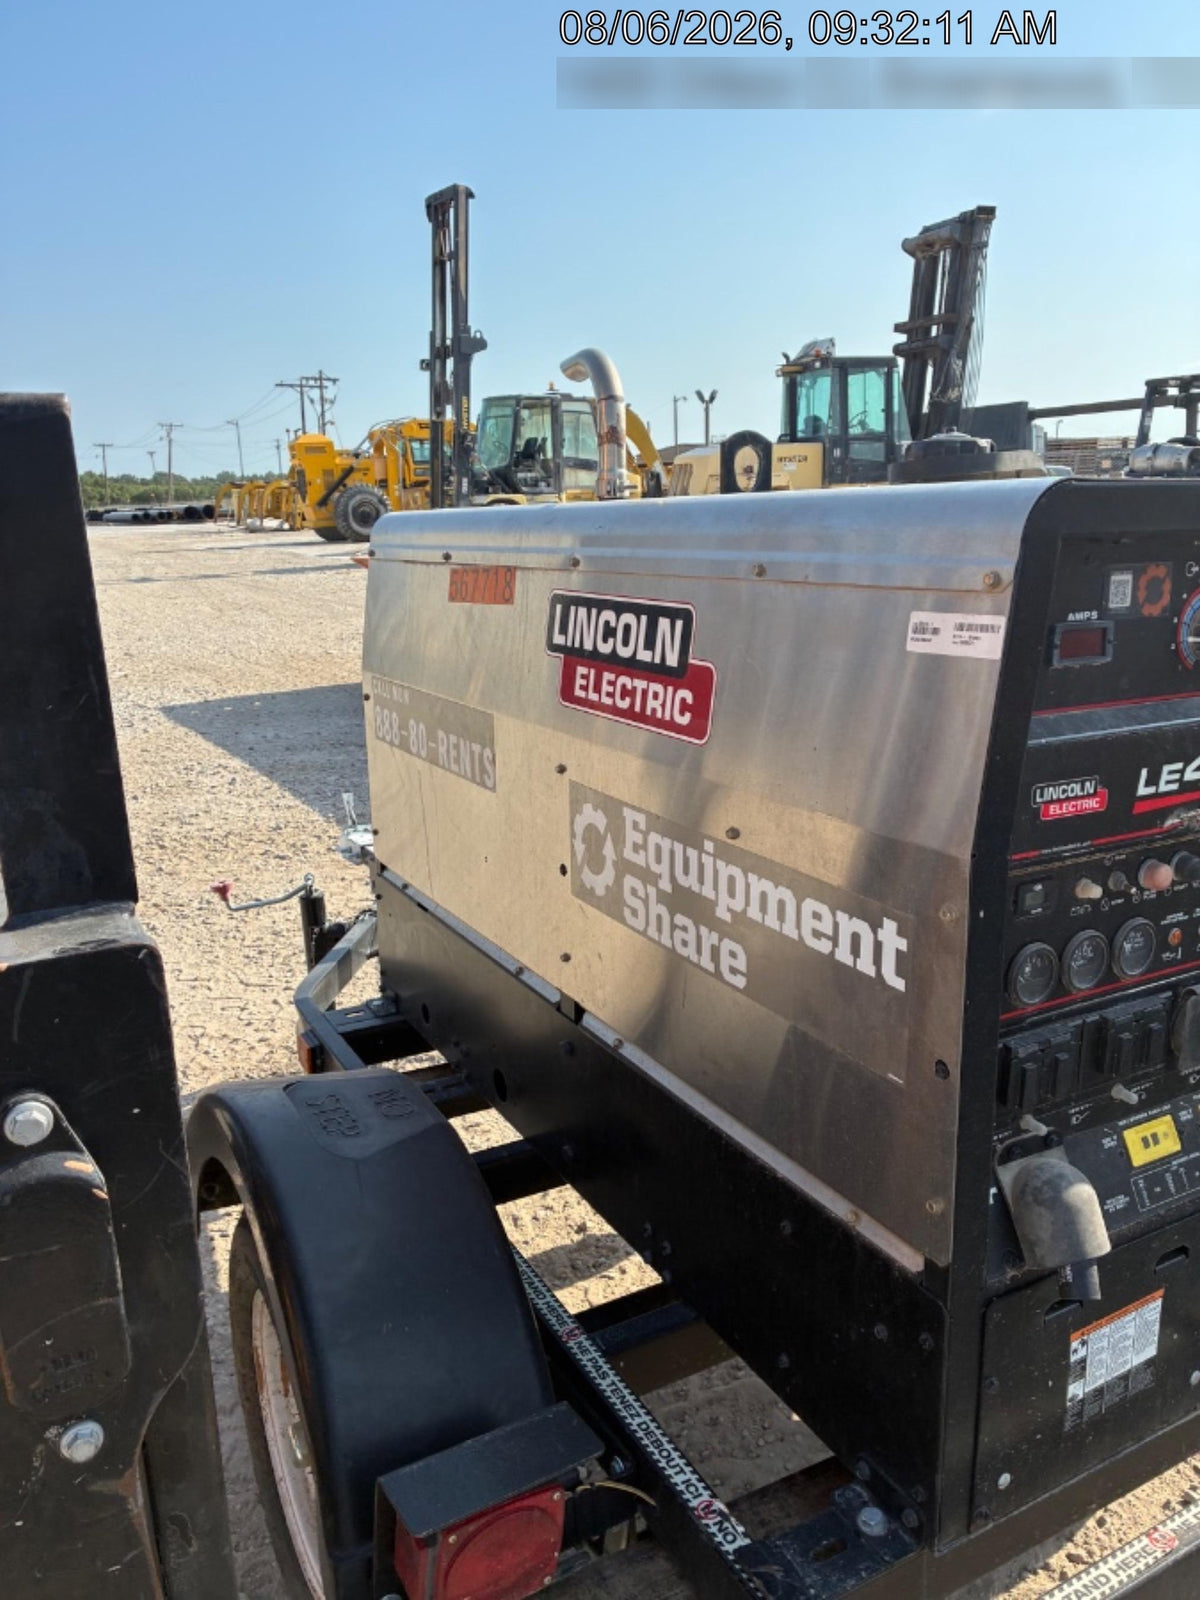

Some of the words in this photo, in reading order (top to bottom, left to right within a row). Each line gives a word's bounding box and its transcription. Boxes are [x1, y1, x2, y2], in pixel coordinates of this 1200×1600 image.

[552, 603, 683, 667] LINCOLN
[1067, 610, 1098, 621] AMPS
[574, 666, 693, 725] ELECTRIC
[375, 705, 495, 788] 888-80-RENTS
[1036, 780, 1095, 802] LINCOLN
[1049, 798, 1100, 814] ELECTRIC
[622, 806, 907, 992] Equipment
[623, 874, 747, 990] Share
[541, 1299, 568, 1330] HERE
[573, 1339, 589, 1357] NE
[585, 1355, 609, 1382] PAS
[604, 1379, 640, 1421] TENEZ
[636, 1419, 686, 1480] DEBOUT
[680, 1476, 703, 1501] ICI
[714, 1518, 738, 1545] NO
[1061, 1573, 1112, 1600] TAND
[1109, 1544, 1157, 1578] HERE
